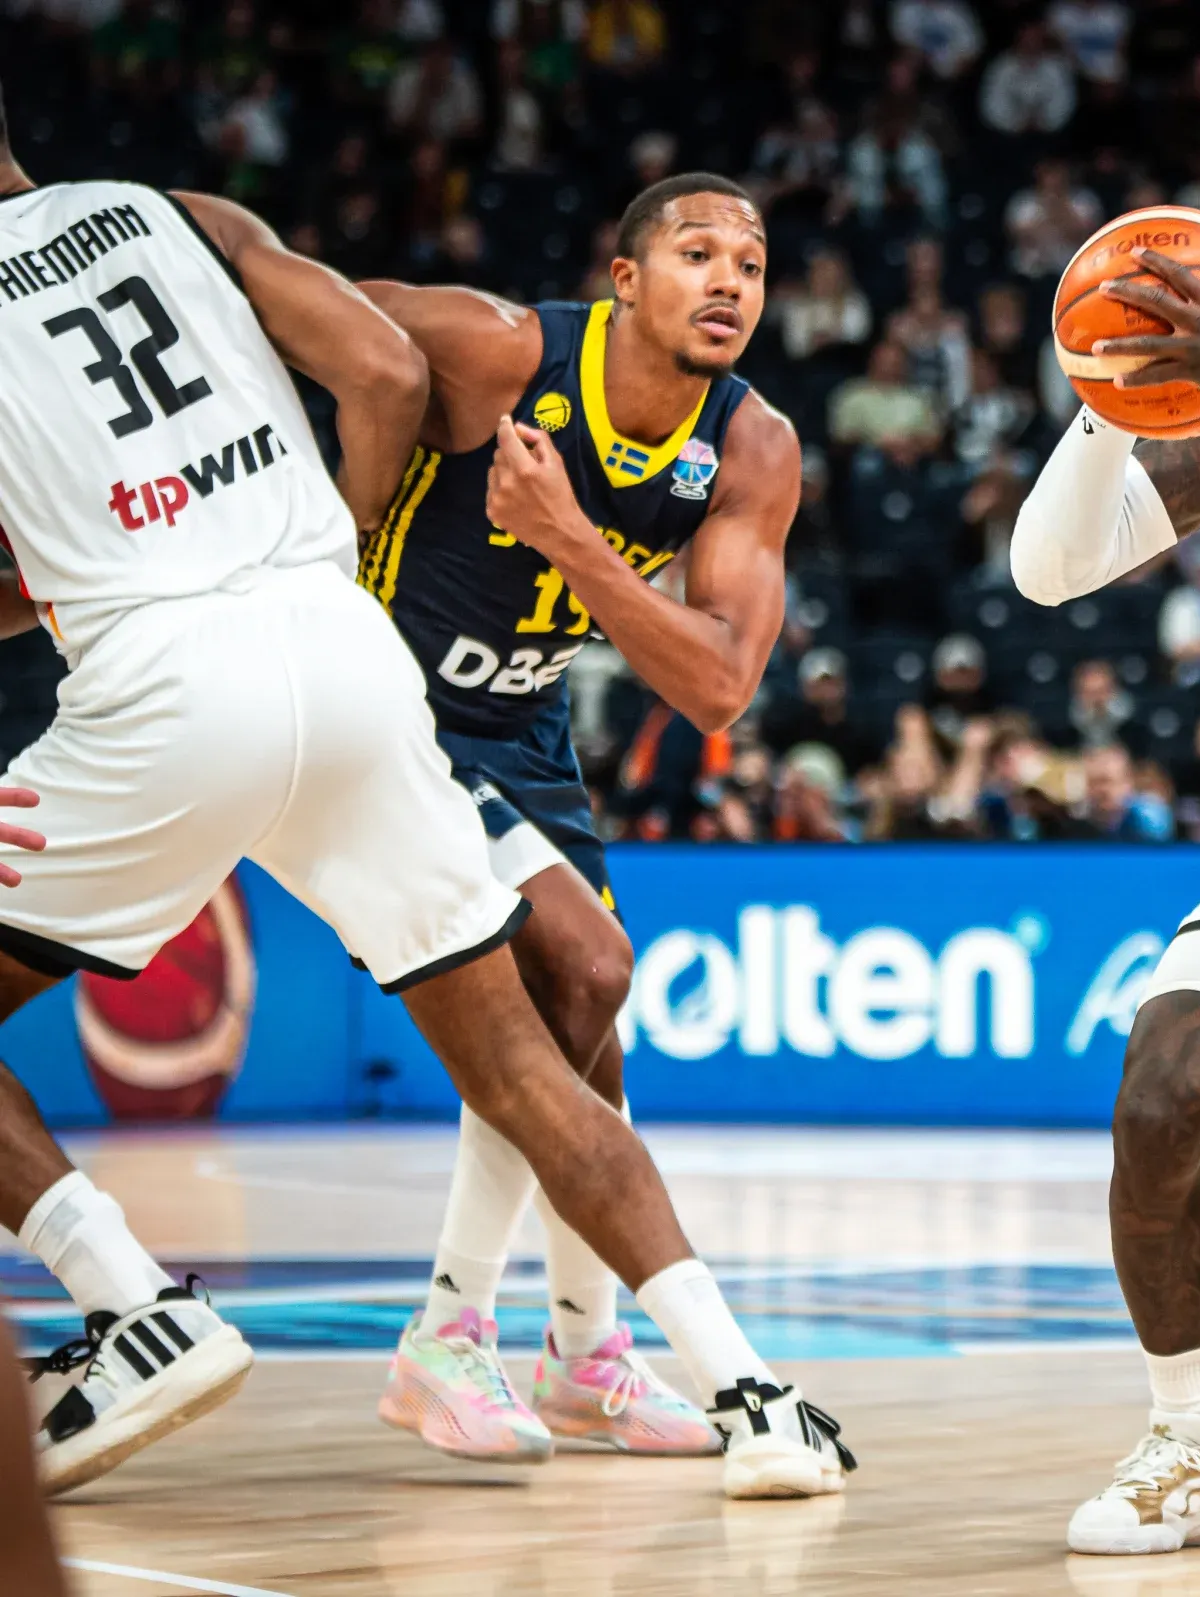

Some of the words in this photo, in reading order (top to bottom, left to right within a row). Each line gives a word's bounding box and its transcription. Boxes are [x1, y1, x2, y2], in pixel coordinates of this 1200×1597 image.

[0, 204, 152, 303] HIEMANN
[41, 275, 213, 440] 32
[109, 423, 288, 532] tipwin
[615, 905, 1034, 1060] olten
